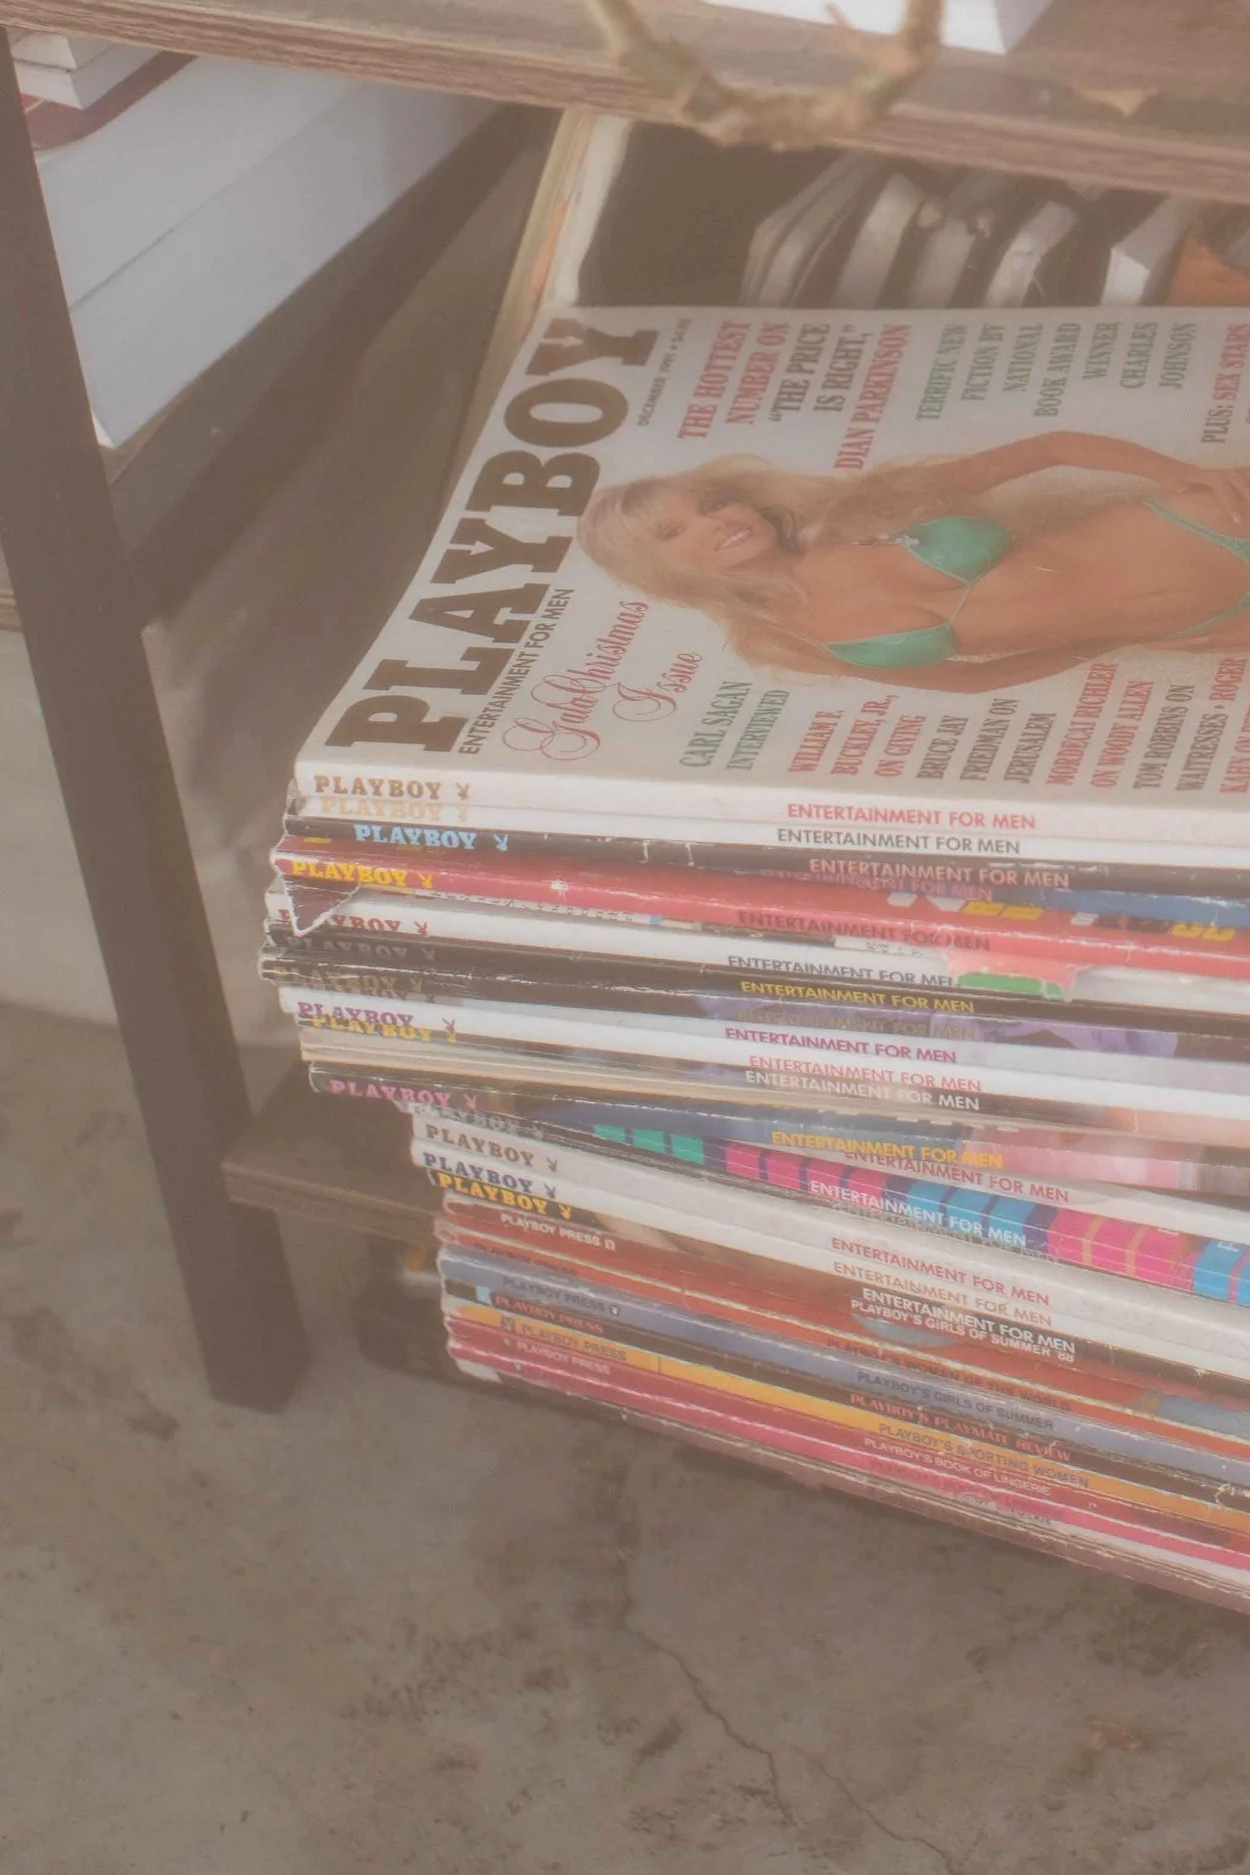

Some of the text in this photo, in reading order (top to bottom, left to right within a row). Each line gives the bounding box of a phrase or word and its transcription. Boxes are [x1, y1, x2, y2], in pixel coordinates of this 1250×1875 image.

[693, 321, 751, 400] HOTTEST
[725, 322, 789, 425] NUMBER ON
[786, 322, 831, 375] PRICE
[916, 324, 967, 421] TERRIFIC NEW
[961, 323, 1005, 401] FICTION BY
[1003, 322, 1043, 392] NATIONAL
[1034, 323, 1082, 417] BOOK AWARD
[1082, 321, 1121, 379] WINNER
[1120, 322, 1157, 388] CHARLES
[1159, 322, 1198, 389] JOHNSON
[813, 395, 845, 413] IS
[834, 322, 912, 469] DIAN PARKINSON
[1213, 374, 1241, 402] SEX
[676, 403, 717, 439] THE
[1201, 404, 1232, 444] PLUS:
[324, 317, 660, 753] PLAYBOY
[459, 588, 575, 755] ENTERTAINMENT FOR MEN
[530, 600, 649, 705] Christmas
[612, 651, 702, 722] Issue
[679, 680, 753, 767] CARL SAGAN
[726, 689, 791, 770] INTERVIEWED
[787, 718, 836, 773] WILLIAM
[830, 718, 886, 775] BUCKLEY,
[874, 715, 926, 777] ON GIVING
[916, 715, 969, 780] BRUCE JAY
[960, 698, 1020, 781] FRIEDMAN ON
[1003, 712, 1057, 784] JERUSALEM
[1046, 663, 1119, 786] MORDECAI RICHLER
[1091, 680, 1154, 788] ON WOODY ALLEN
[1133, 684, 1195, 790] TOM ROBBINS ON
[1175, 658, 1247, 791] WAITRESSES ROGER
[314, 775, 442, 800] PLAYBOY
[788, 803, 1036, 831] ENTERTAINMENT FOR MEN
[354, 824, 478, 850] PLAYBOY
[777, 828, 1021, 854] ENTERTAINMENT FOR MEN
[810, 858, 972, 883] ENTERTAINMENT
[979, 867, 1017, 885] FOR
[1024, 871, 1069, 888] MEN
[741, 981, 974, 1013] ENTERTAINMENT FOR MEN
[423, 1152, 534, 1194] PLAYBOY
[425, 1124, 535, 1167] PLAYBOY
[437, 1172, 547, 1215] PLAYBOY
[856, 1371, 1054, 1429] PLAYBOY'S GIRLS OF SUMMER
[864, 1437, 932, 1464] PLAYBOY'S
[935, 1457, 972, 1475] BOOK
[974, 1467, 991, 1479] OF
[879, 1423, 1089, 1488] PLAYBOY'S SPORTING WOMEN
